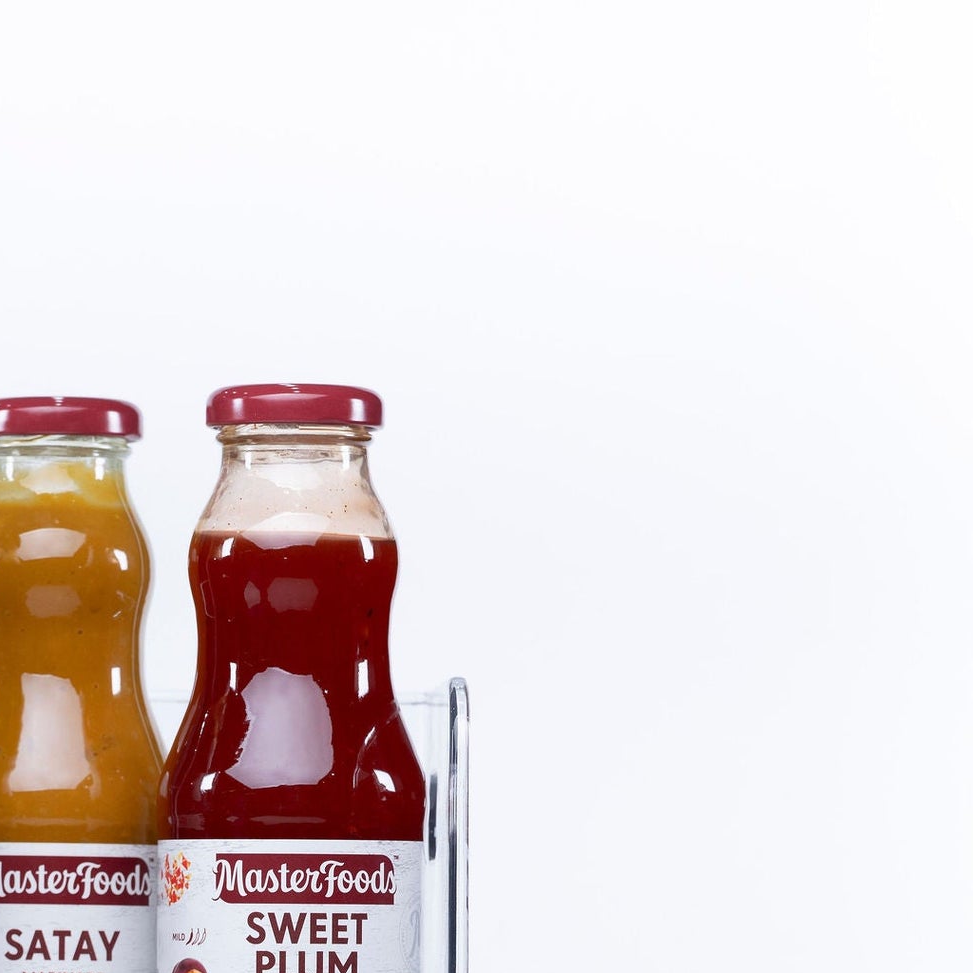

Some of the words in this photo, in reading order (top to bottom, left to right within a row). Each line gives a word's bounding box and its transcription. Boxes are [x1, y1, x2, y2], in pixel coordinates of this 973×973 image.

[212, 859, 397, 901] MasterFoods
[4, 929, 120, 961] SATAY
[246, 911, 368, 945] SWEET
